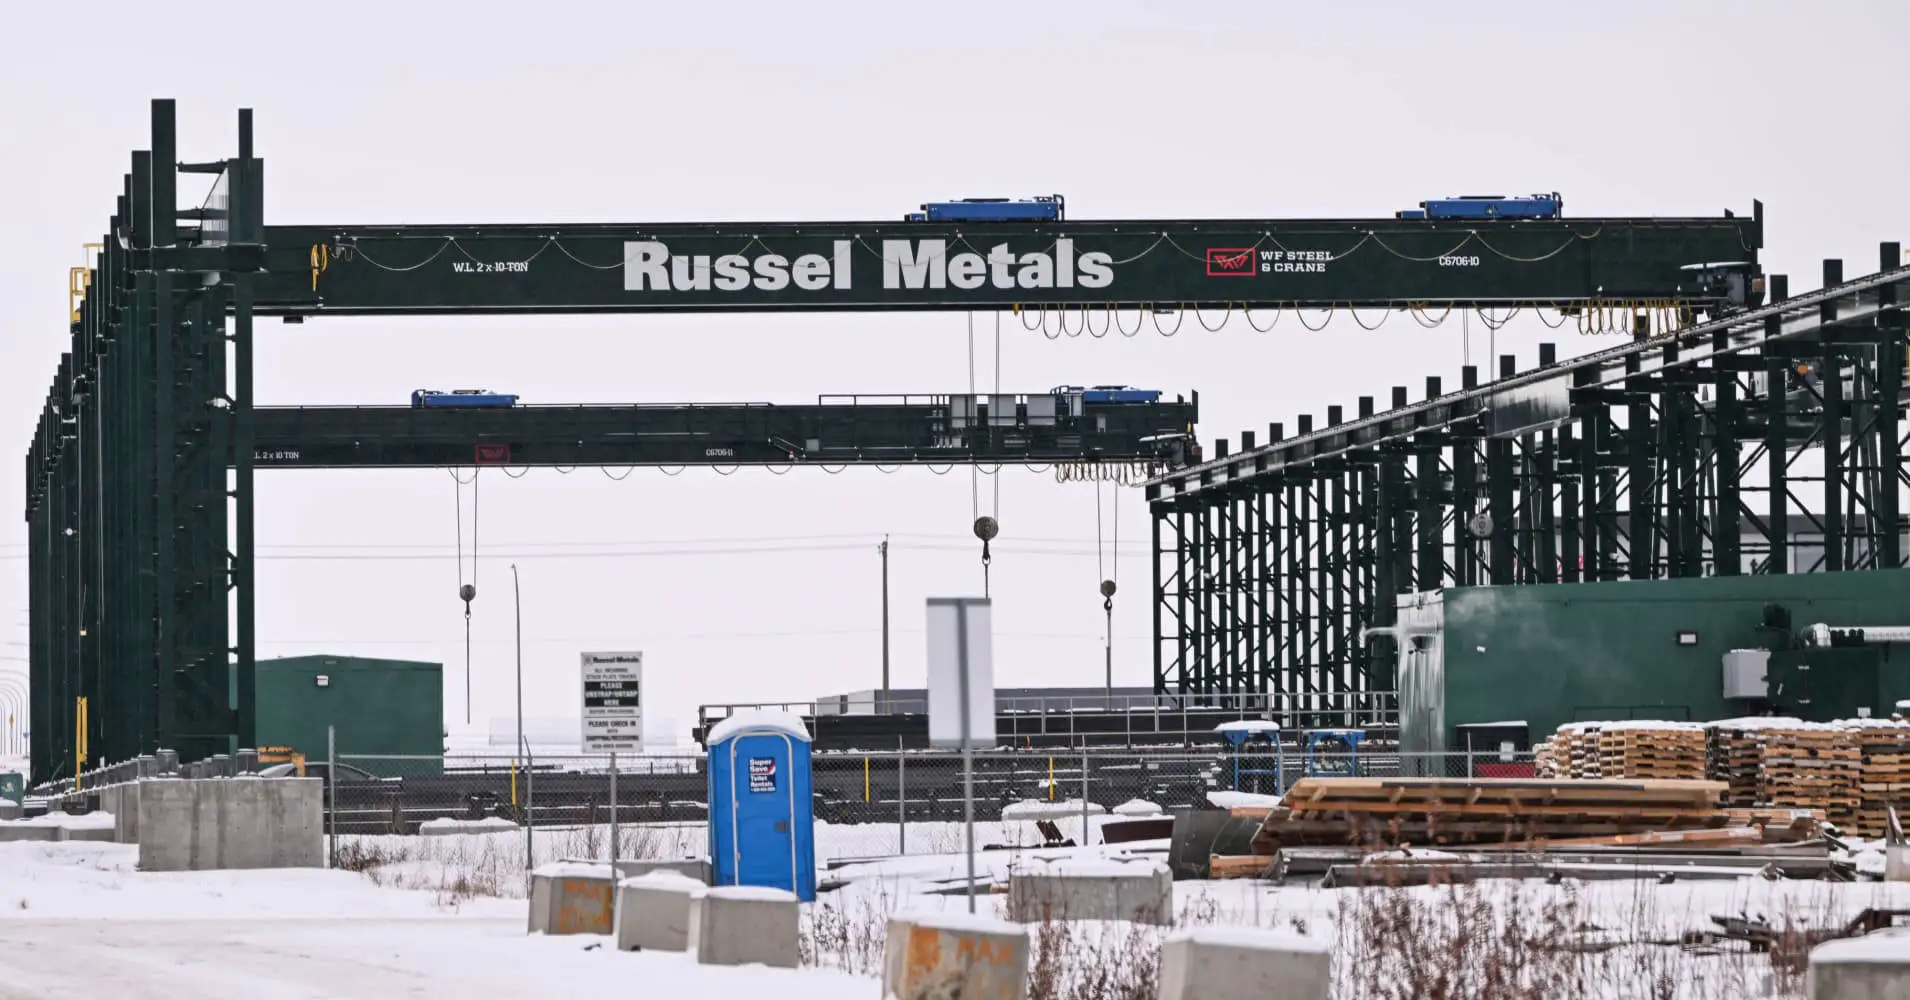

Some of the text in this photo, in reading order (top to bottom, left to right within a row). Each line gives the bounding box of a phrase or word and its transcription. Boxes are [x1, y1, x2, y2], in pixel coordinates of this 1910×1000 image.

[1260, 250, 1334, 261] WF STEEL
[624, 238, 1114, 291] Russel Metals
[1439, 256, 1480, 266] C6706-10
[453, 262, 475, 272] W.L.
[476, 262, 484, 272] 2
[1274, 263, 1326, 272] CRANE
[284, 451, 300, 460] TON
